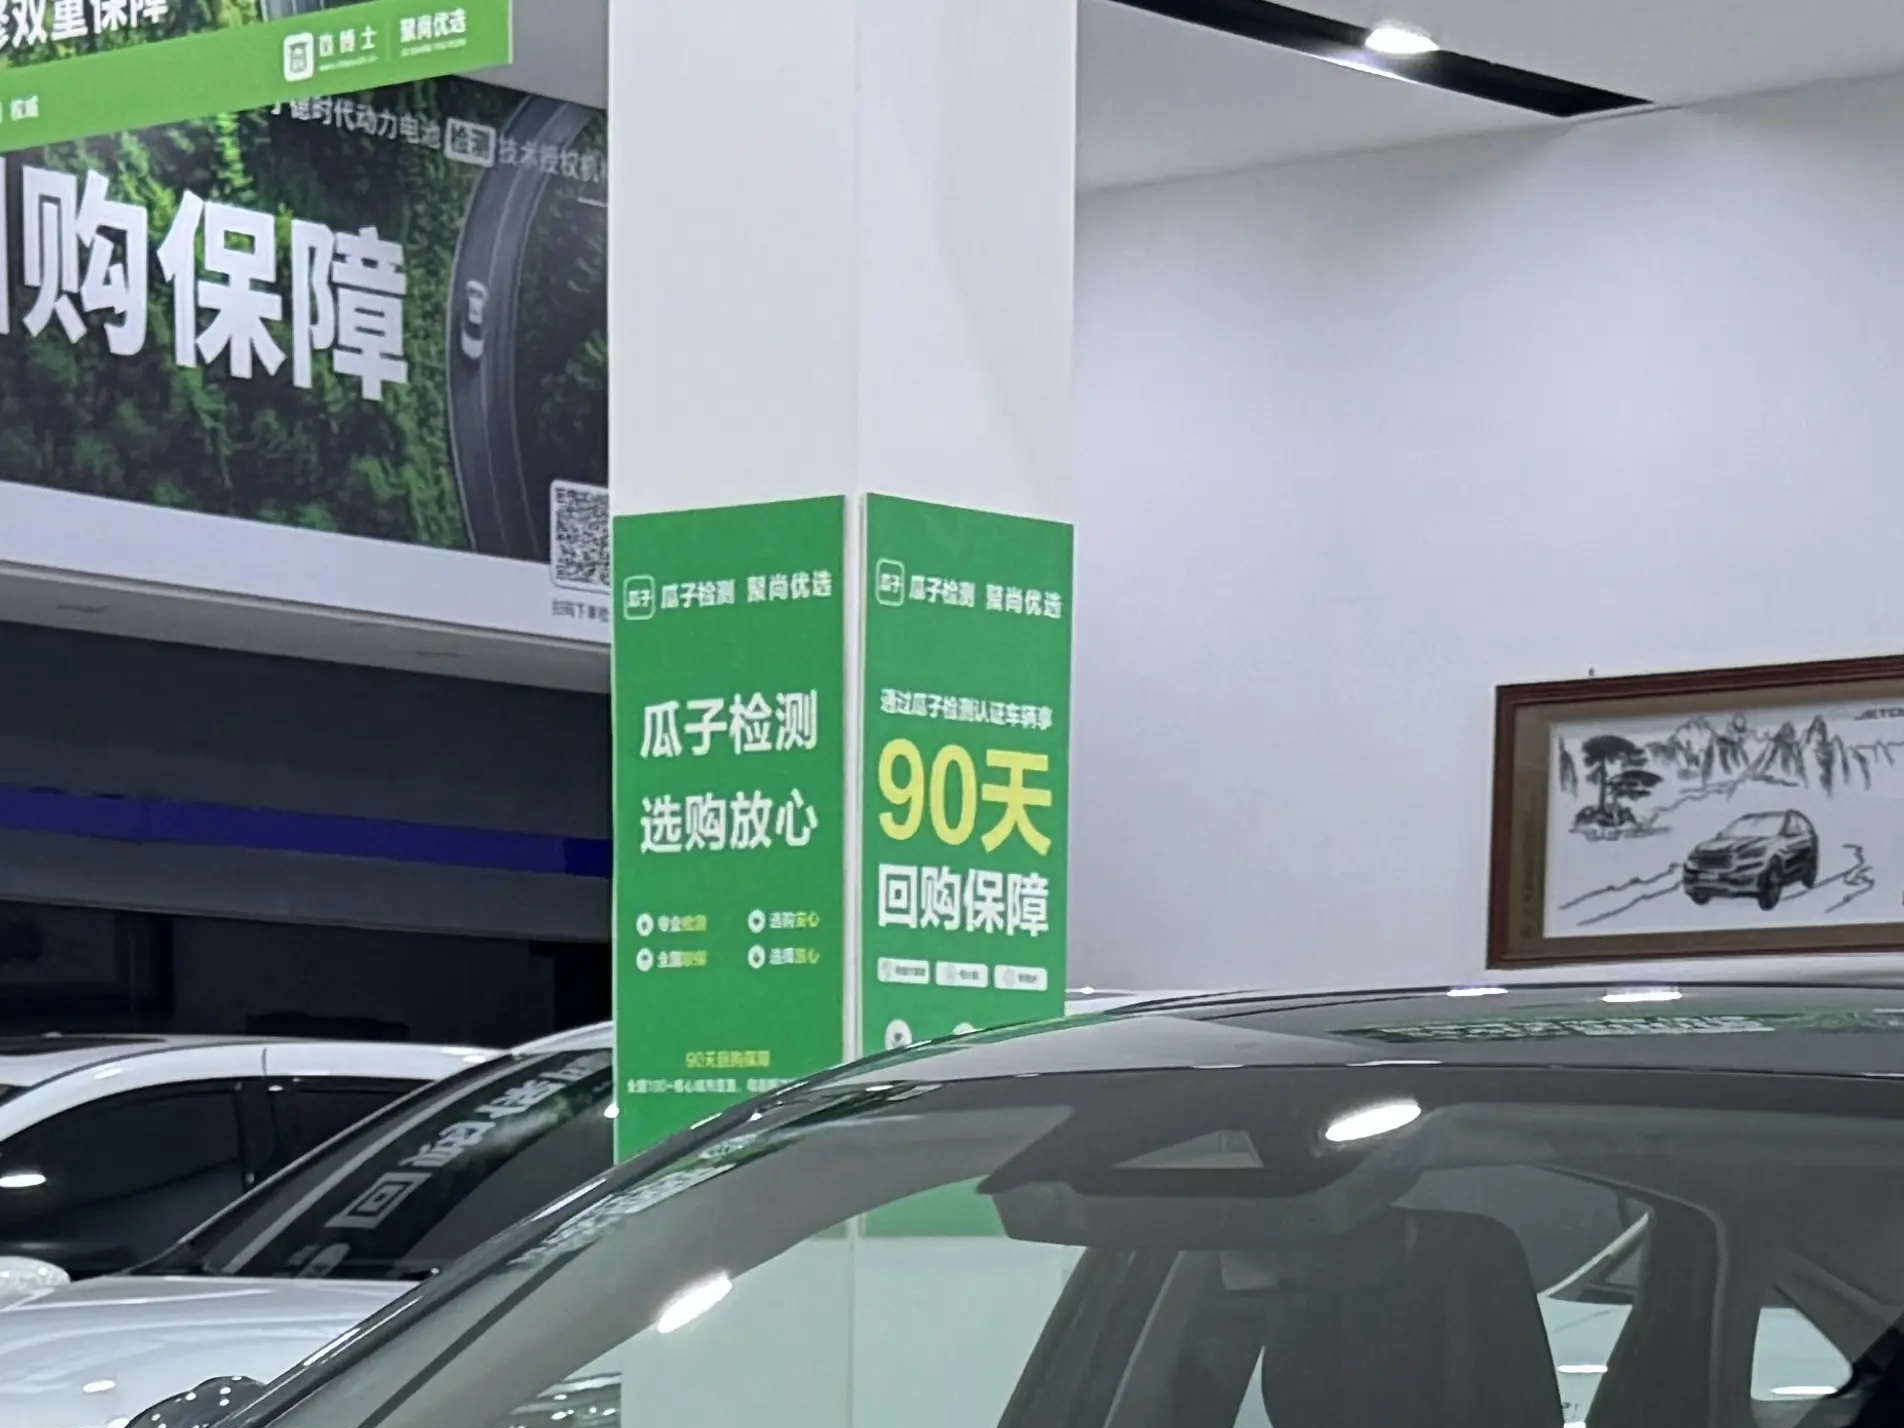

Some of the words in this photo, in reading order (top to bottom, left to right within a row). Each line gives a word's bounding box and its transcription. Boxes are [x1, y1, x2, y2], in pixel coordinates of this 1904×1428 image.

[639, 689, 819, 759] 瓜子检测
[639, 788, 819, 855] 选购放心
[878, 738, 1054, 857] 90天
[877, 862, 1050, 938] 回购保障
